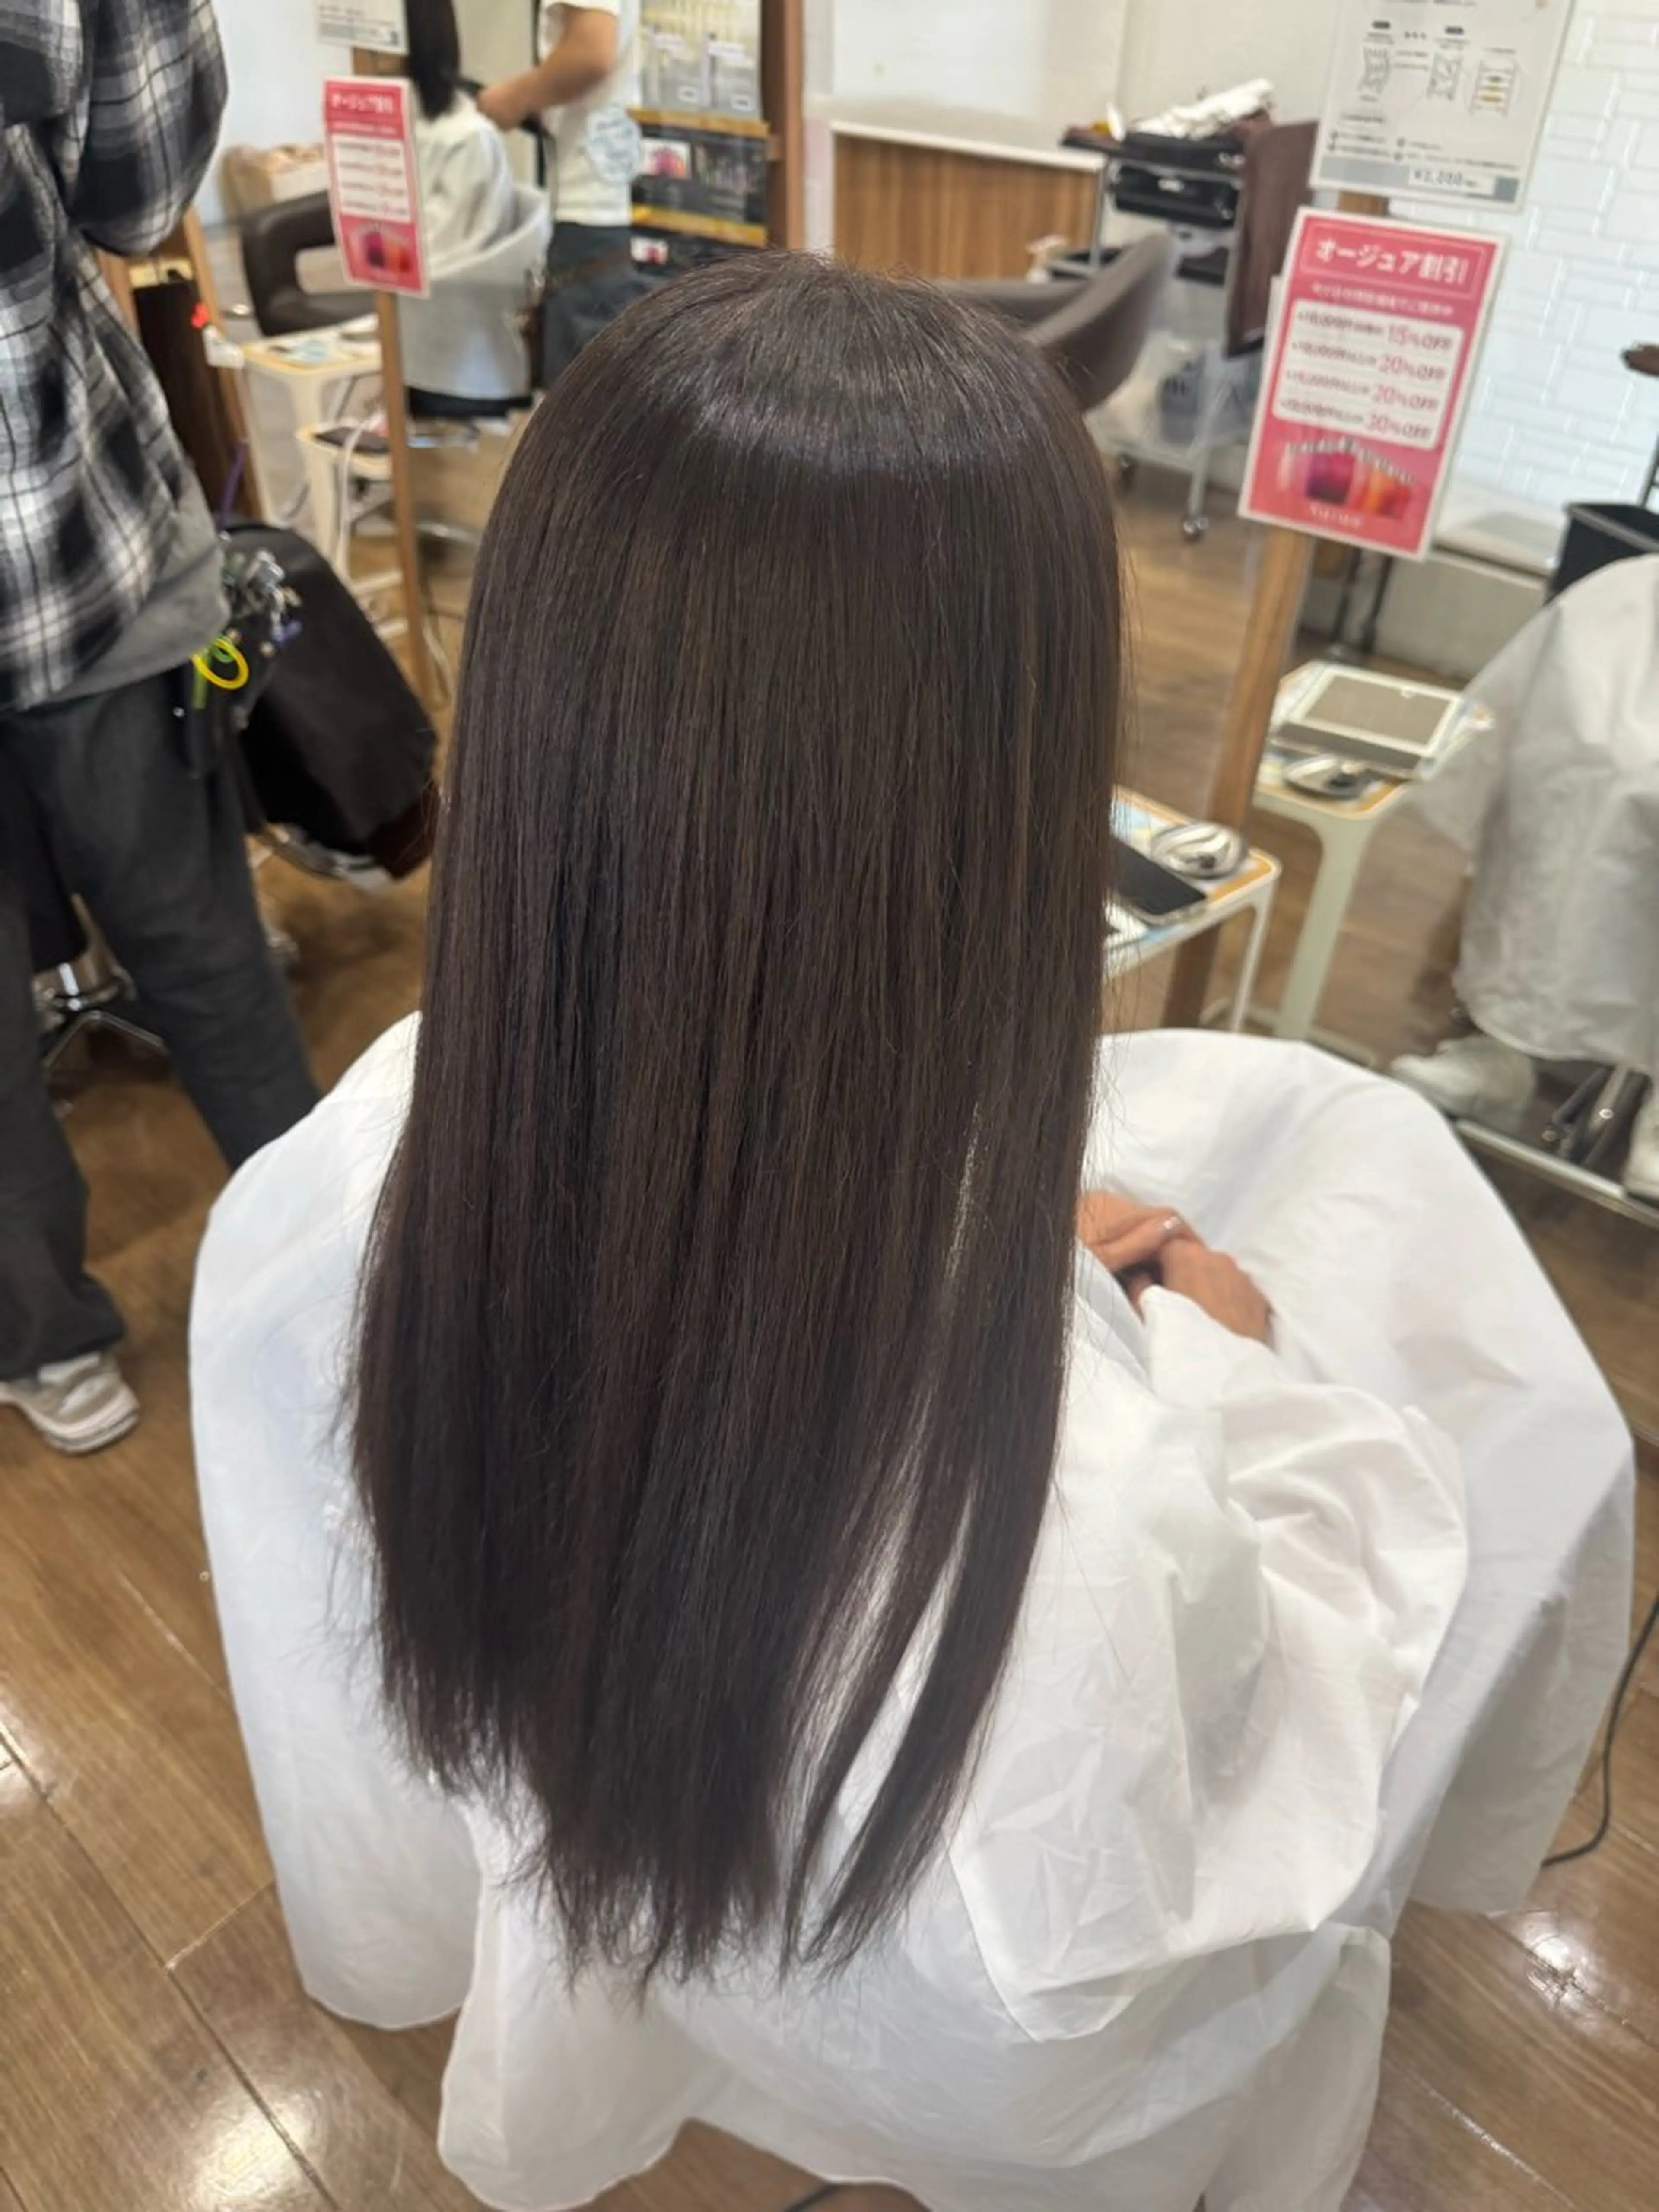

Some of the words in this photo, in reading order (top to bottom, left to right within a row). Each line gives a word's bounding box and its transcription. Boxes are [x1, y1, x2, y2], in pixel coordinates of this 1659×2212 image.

[1316, 238, 1469, 285] オージュア割引
